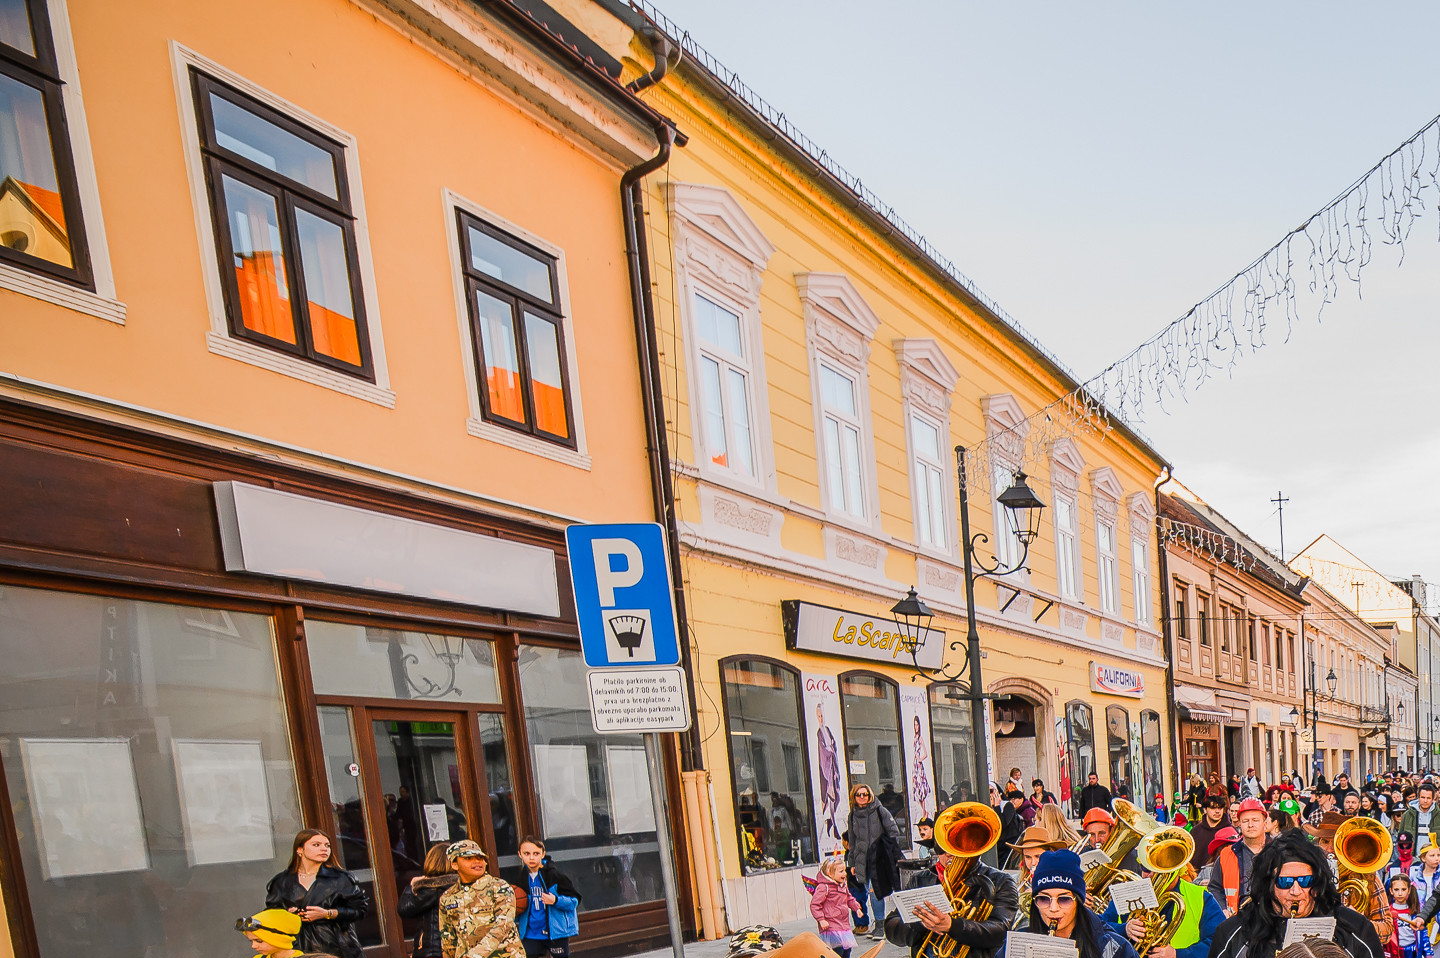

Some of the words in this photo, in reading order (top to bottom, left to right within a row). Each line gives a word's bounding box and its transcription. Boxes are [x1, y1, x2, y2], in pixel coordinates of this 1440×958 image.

[591, 537, 643, 607] P
[833, 616, 858, 645] La
[806, 678, 836, 694] ara
[1097, 666, 1142, 688] CALIFORNIA
[1037, 875, 1073, 886] POLICIJA
